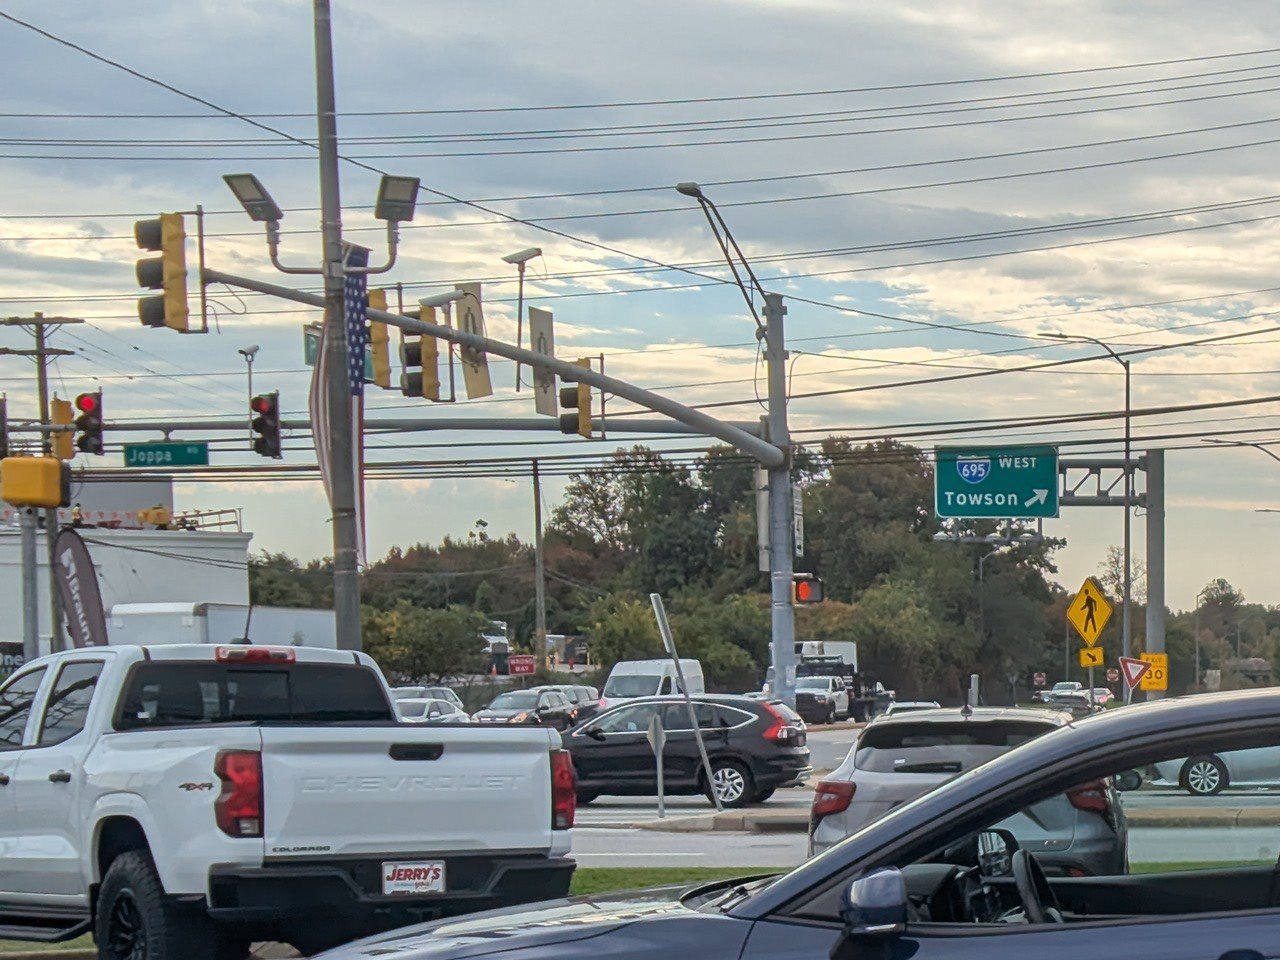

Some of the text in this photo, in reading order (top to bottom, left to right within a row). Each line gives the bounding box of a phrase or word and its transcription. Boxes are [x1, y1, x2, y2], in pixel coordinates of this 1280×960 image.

[129, 448, 172, 465] Joppa
[962, 456, 1037, 477] 695 WEST
[945, 491, 1018, 506] Towson
[1144, 669, 1163, 680] 30
[301, 773, 527, 793] CHEVROLET
[386, 865, 441, 881] JERRY'S
